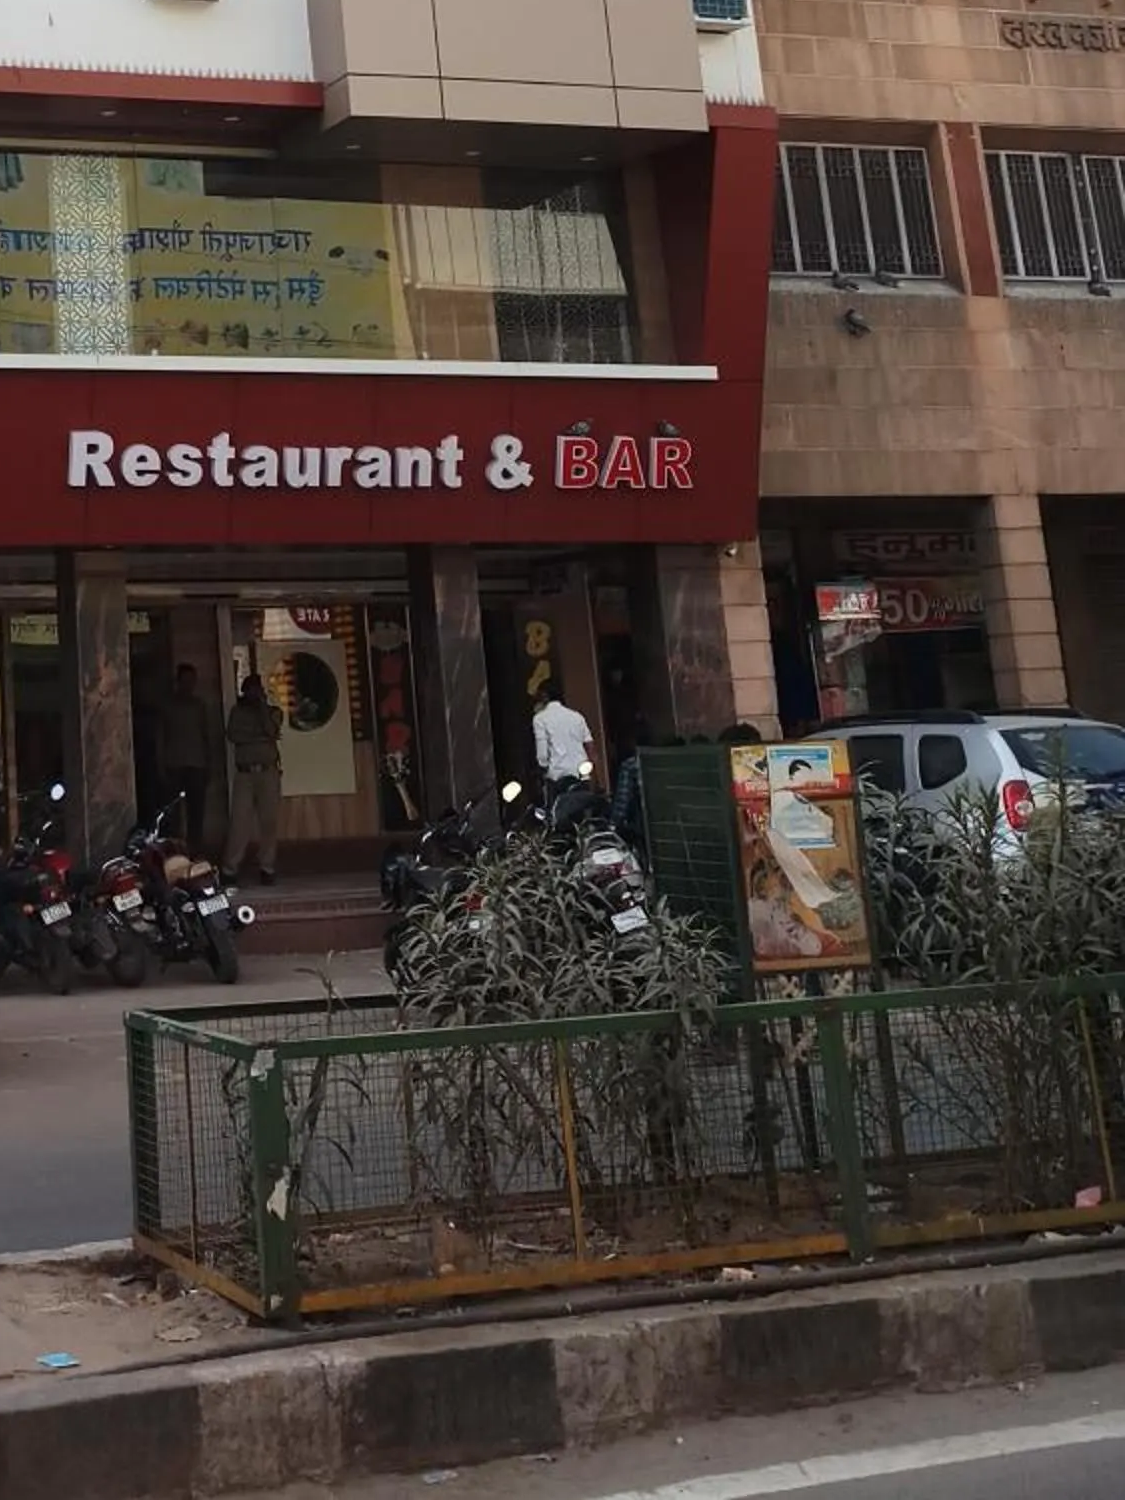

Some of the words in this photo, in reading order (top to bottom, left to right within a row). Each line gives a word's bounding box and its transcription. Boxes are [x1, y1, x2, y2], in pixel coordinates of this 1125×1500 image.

[66, 430, 465, 489] Restaurant
[483, 434, 535, 489] &
[554, 434, 694, 490] BAR
